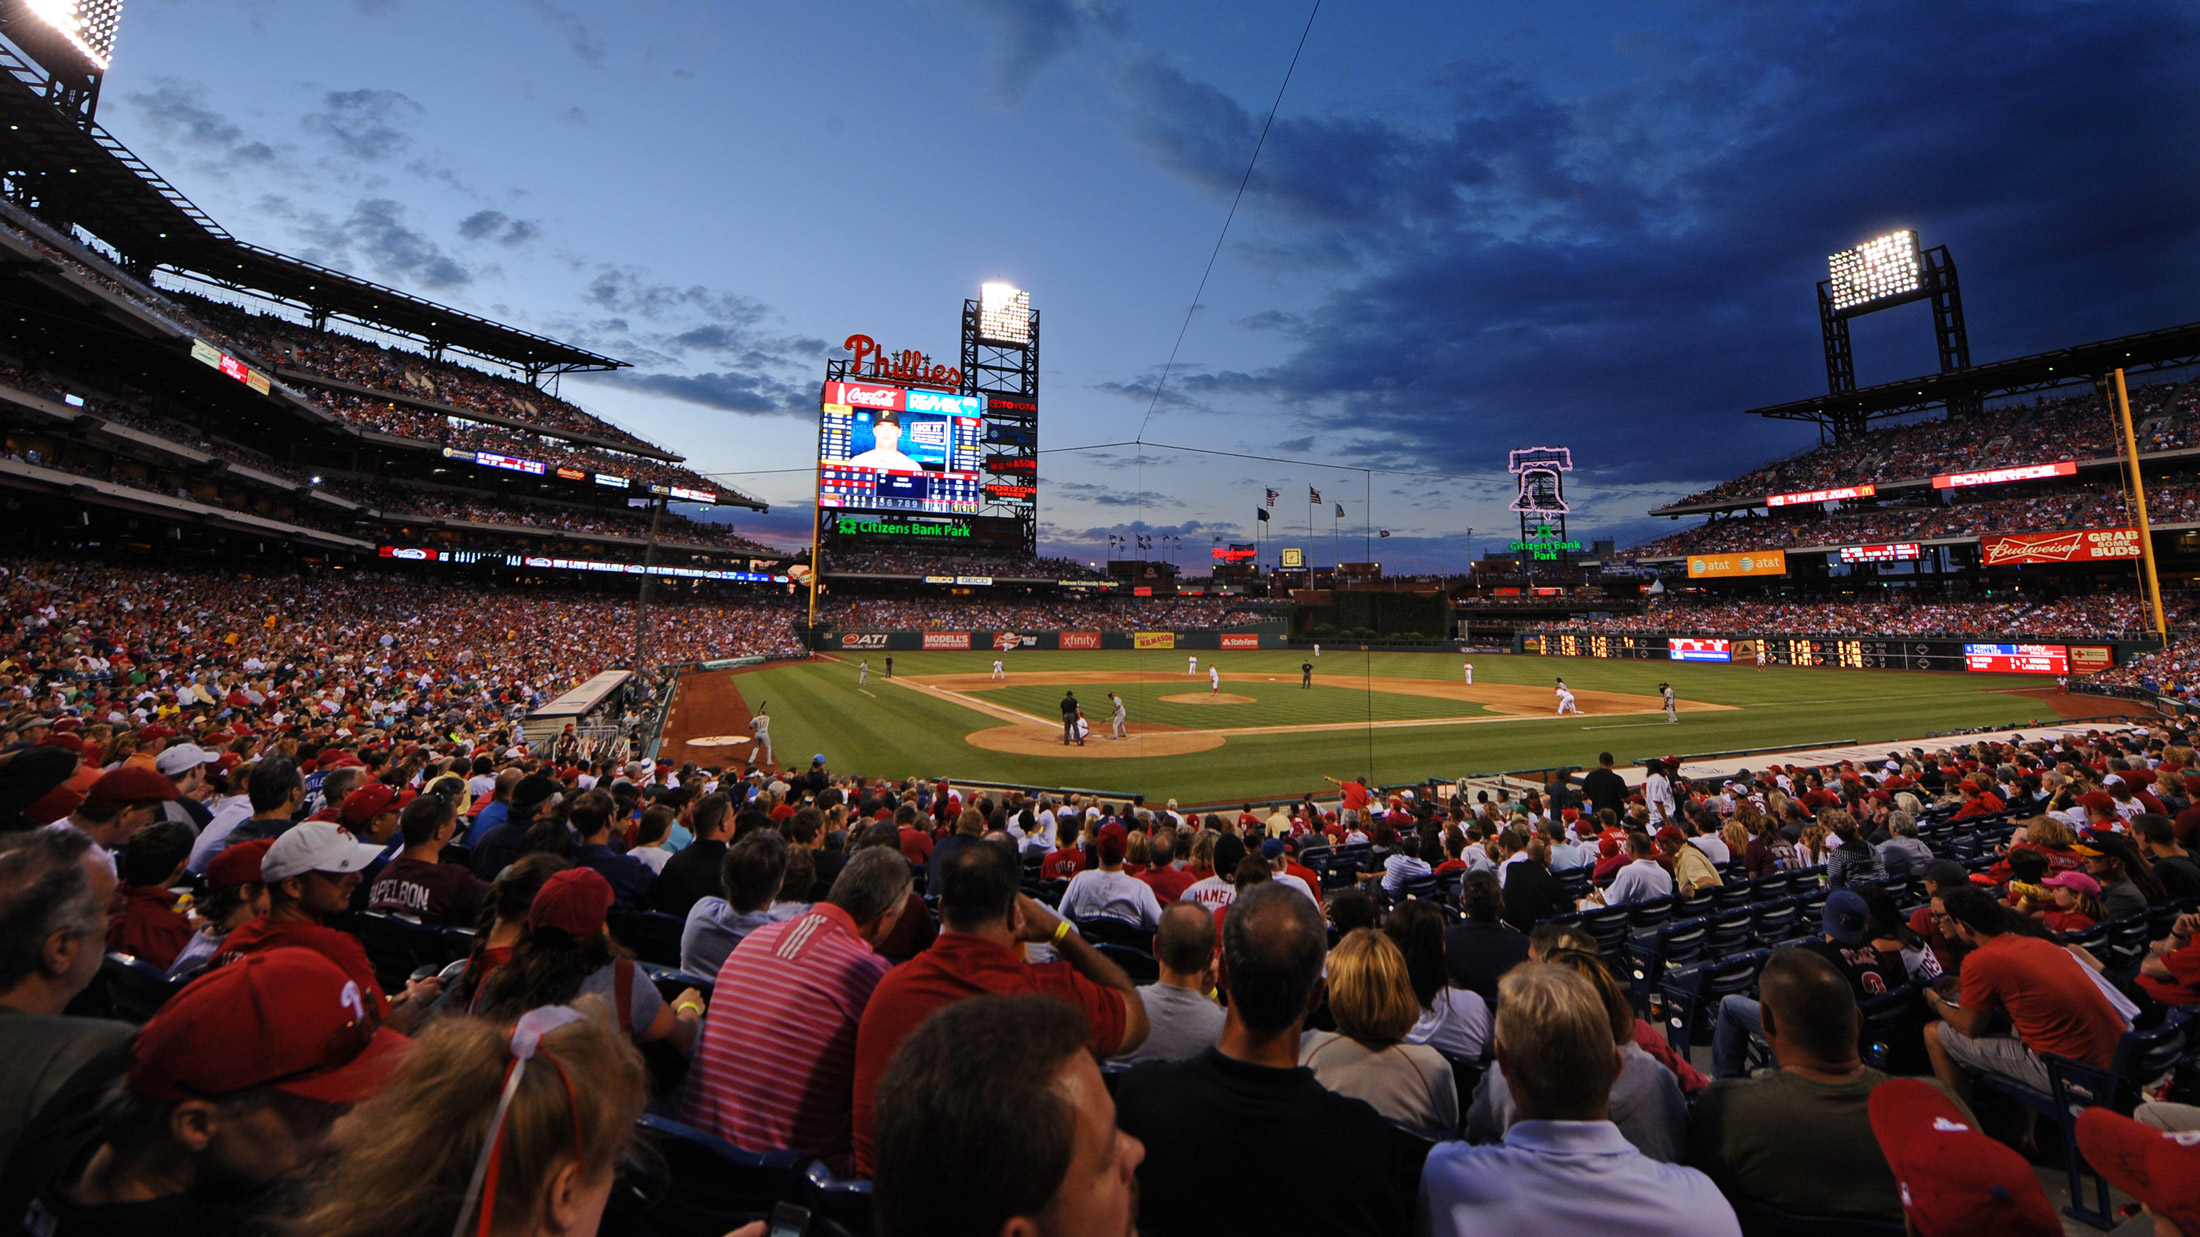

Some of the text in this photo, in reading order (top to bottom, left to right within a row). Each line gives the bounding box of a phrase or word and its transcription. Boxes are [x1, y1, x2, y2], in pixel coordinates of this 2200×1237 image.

[844, 334, 962, 384] Phillies
[846, 387, 898, 407] Coca-Cola
[909, 393, 962, 414] RE/MAX
[1001, 401, 1036, 411] TOYOTA
[882, 410, 889, 419] P
[986, 484, 1036, 494] HORIZON
[1797, 493, 1811, 502] ANY
[1812, 491, 1827, 500] SIZE
[860, 520, 971, 537] Citizens Bank Park
[2087, 530, 2138, 542] GRAB
[1510, 540, 1581, 551] Citizens Bank
[1985, 541, 2140, 558] Budweiser BUDS
[2097, 540, 2131, 548] SOME
[1533, 551, 1557, 560] Park
[553, 559, 568, 568] WE
[588, 562, 624, 572] PHILLIES
[1708, 557, 1780, 571] at&t at&t
[858, 634, 888, 644] ATI
[925, 635, 968, 643] MODELL'S
[1064, 635, 1097, 648] xfinity
[2018, 644, 2046, 653] xfinity
[1055, 860, 1077, 873] UTLEY
